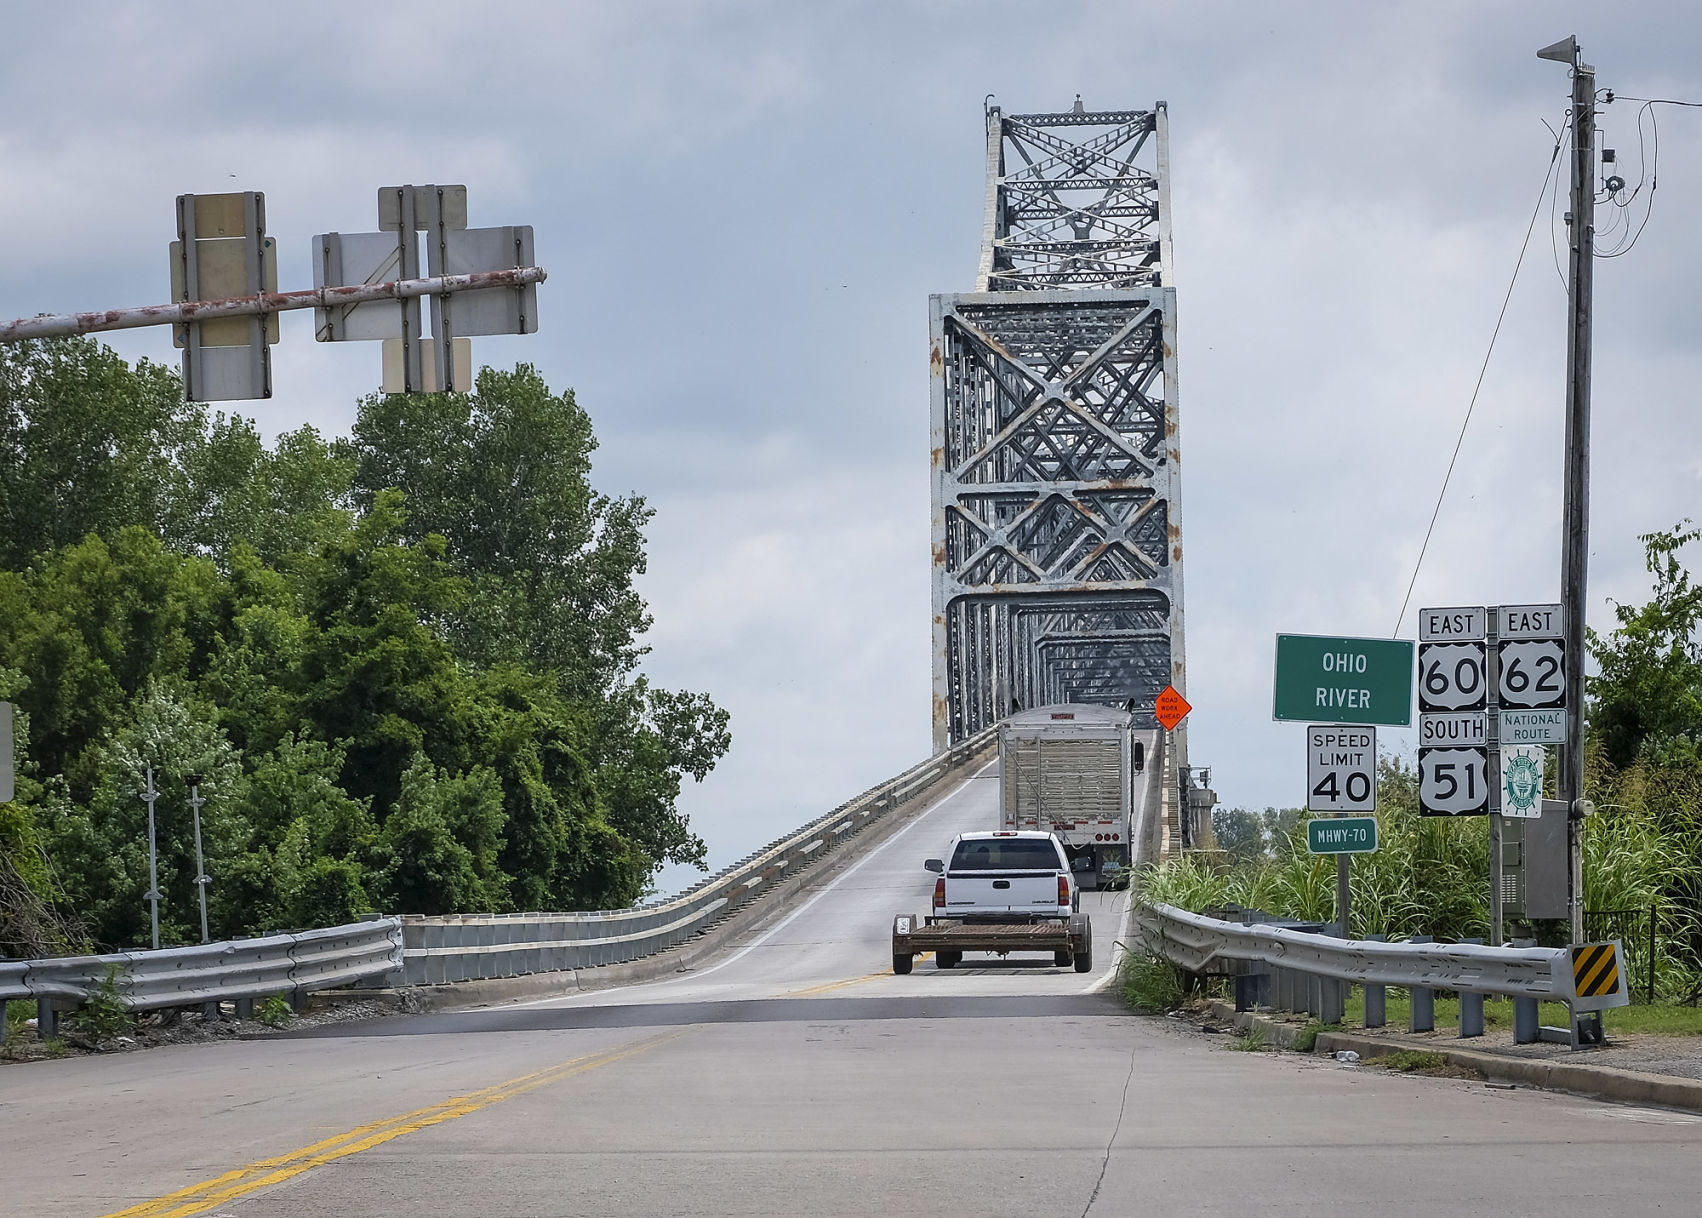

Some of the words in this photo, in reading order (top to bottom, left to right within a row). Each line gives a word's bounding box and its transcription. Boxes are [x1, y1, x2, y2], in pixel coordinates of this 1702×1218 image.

[1430, 614, 1474, 634] EAST
[1508, 612, 1553, 631] EAST
[1322, 652, 1367, 673] OHIO
[1425, 657, 1479, 695] 60
[1505, 655, 1559, 692] 62
[1315, 687, 1371, 709] RIVER
[1423, 719, 1483, 739] SOUTH
[1504, 713, 1561, 725] NATIONAL
[1313, 735, 1370, 747] SPEED
[1514, 729, 1551, 739] ROUTE
[1319, 753, 1364, 766] LIMIT
[1312, 772, 1371, 802] 40
[1433, 763, 1475, 800] 51
[1317, 828, 1367, 843] MHWY-70
